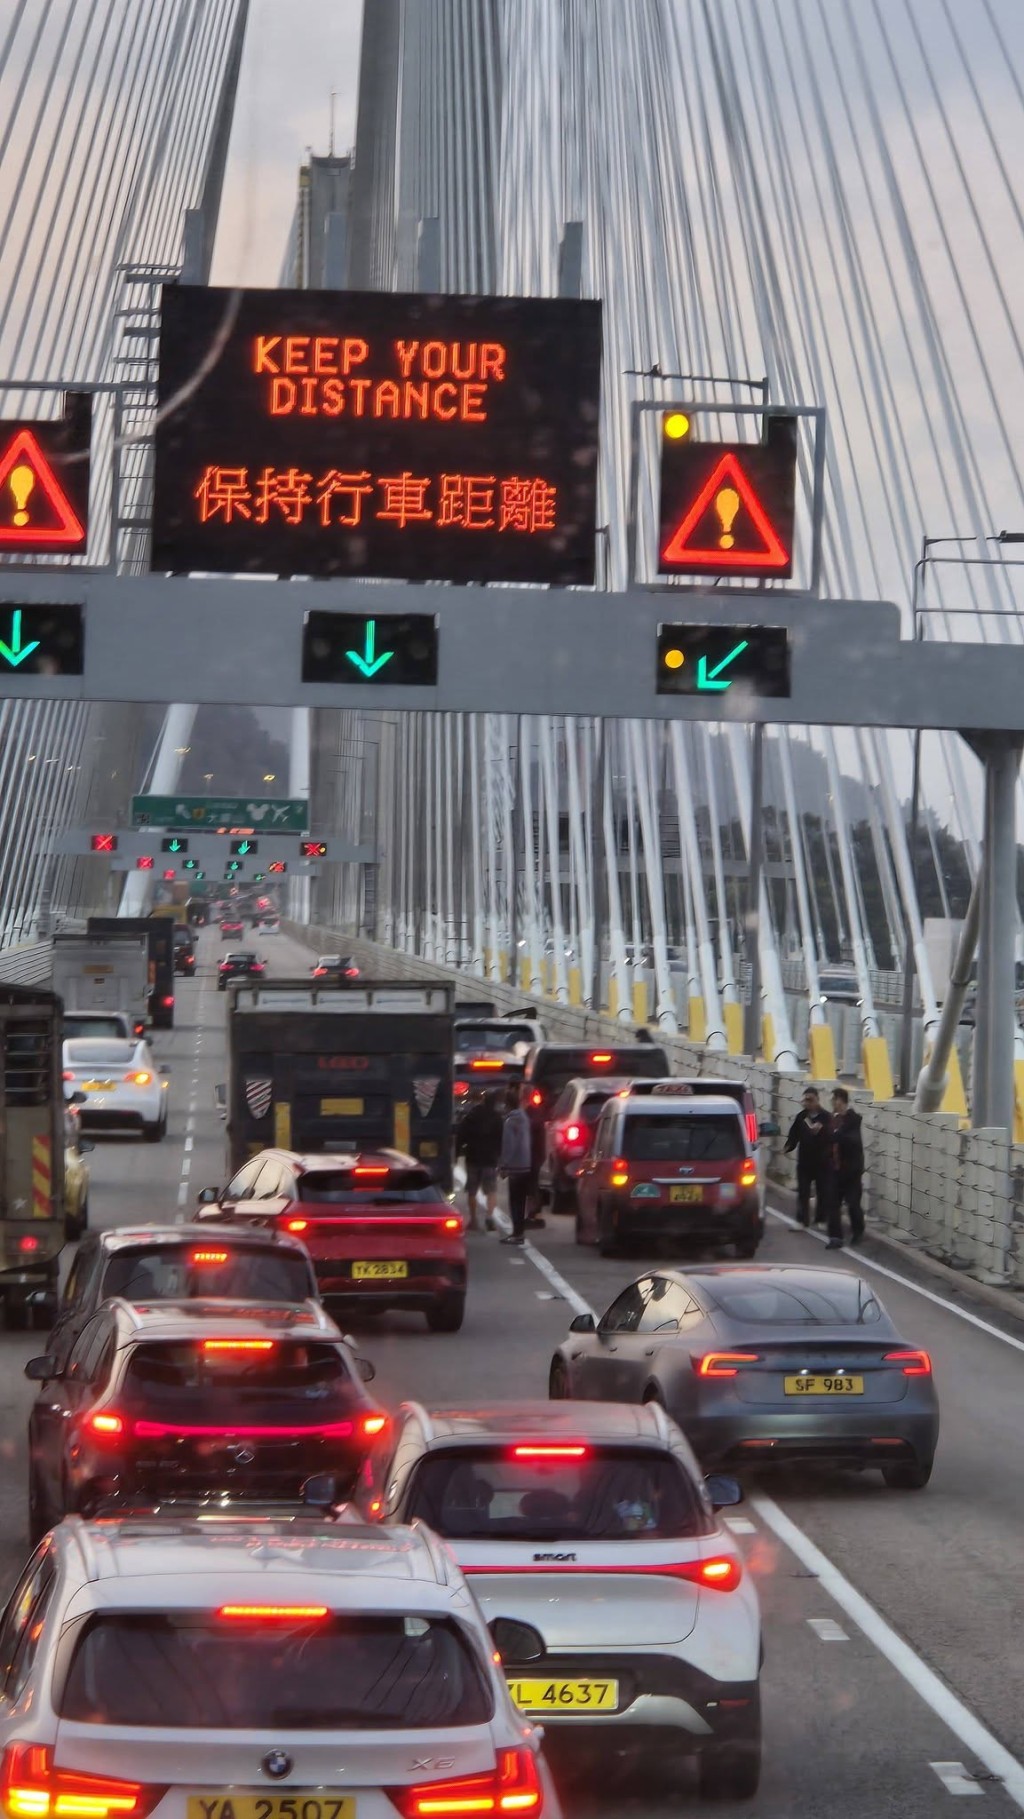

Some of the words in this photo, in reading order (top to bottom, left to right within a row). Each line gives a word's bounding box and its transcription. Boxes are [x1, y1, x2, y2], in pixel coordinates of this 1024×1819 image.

[253, 335, 370, 375] KEEP
[396, 340, 507, 381] YOUR
[269, 377, 489, 422] DISTANCE
[194, 464, 557, 533] 保持行車距離
[795, 1378, 816, 1392] SF
[823, 1378, 854, 1392] 983
[533, 1553, 576, 1562] smart
[541, 1683, 609, 1705] 4637
[199, 1800, 236, 1819] YA
[254, 1799, 343, 1819] 2507
